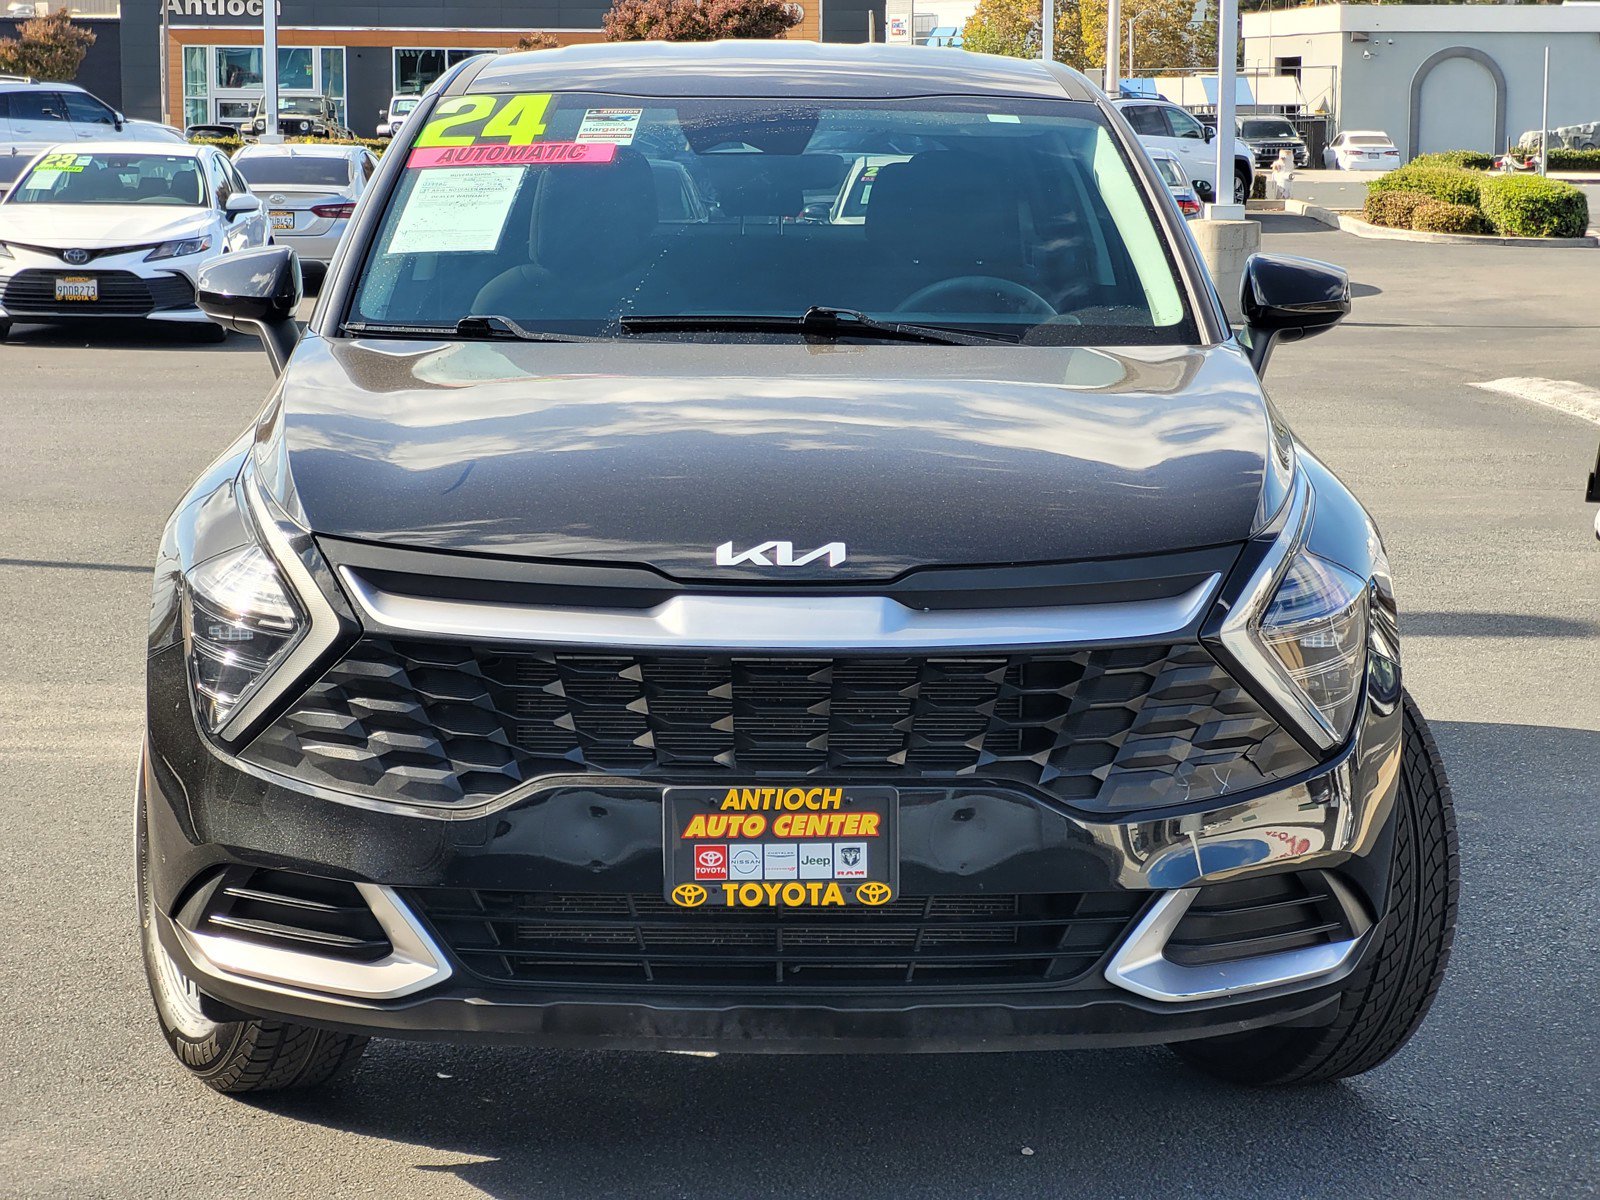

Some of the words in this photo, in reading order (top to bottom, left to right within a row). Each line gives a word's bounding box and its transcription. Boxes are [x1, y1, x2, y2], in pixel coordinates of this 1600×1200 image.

[414, 94, 552, 147] 24
[435, 144, 589, 163] AUTOMATIC
[716, 541, 846, 567] KIA
[720, 788, 843, 811] ANTIOCH
[681, 813, 768, 839] AUTO
[772, 812, 881, 838] CENTER
[801, 856, 831, 866] Jeep
[722, 882, 846, 907] TOYOTA
